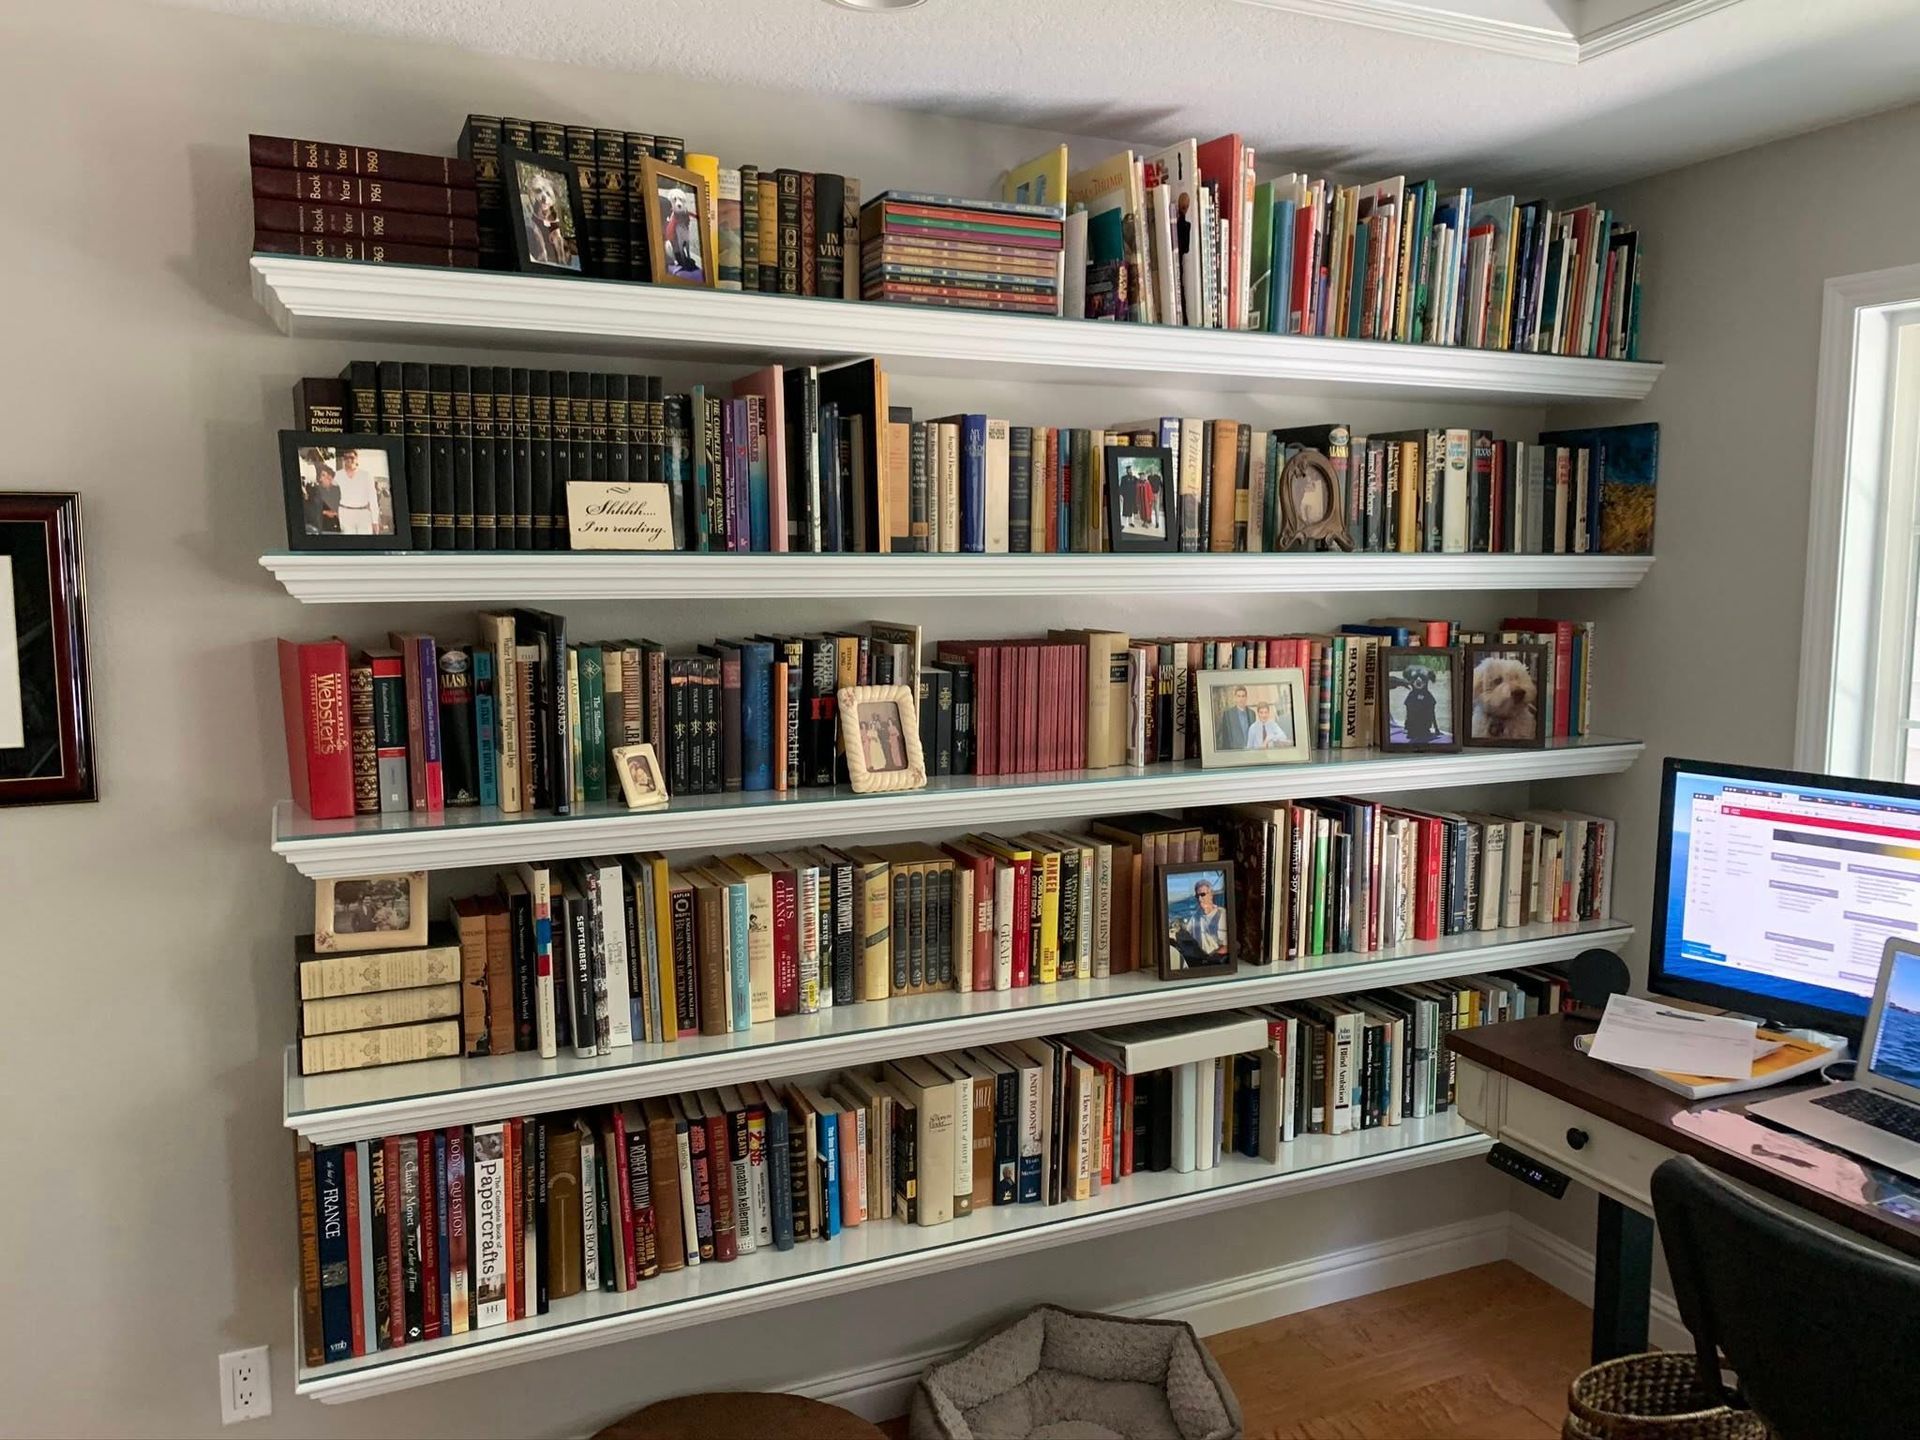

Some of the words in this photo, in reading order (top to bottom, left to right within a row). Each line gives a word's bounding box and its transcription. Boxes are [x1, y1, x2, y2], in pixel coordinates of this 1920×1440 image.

[368, 151, 378, 173] 1960
[310, 175, 321, 199] Book
[341, 180, 351, 201] Year
[371, 184, 382, 202] 1961
[313, 209, 324, 233] Book
[344, 213, 353, 234] Year
[373, 216, 384, 236] 1962
[315, 239, 324, 257] ook
[346, 243, 354, 260] ear
[820, 244, 843, 256] VIVO
[826, 233, 838, 244] IN
[373, 247, 384, 263] 963
[712, 399, 720, 415] THE
[749, 398, 758, 423] CLIVE
[713, 417, 721, 461] COMPLETE
[750, 425, 759, 462] CUSSLER
[1329, 446, 1349, 458] ALASKA
[1434, 434, 1446, 470] SPACE
[1475, 448, 1492, 457] TEXAS
[714, 463, 722, 486] BOOK
[716, 497, 724, 535] RUNNING
[613, 521, 667, 543] reading.
[556, 636, 564, 653] THE
[784, 643, 803, 655] STEPHEN
[1365, 643, 1377, 673] NAKED
[556, 655, 564, 671] ART
[789, 655, 799, 666] KING
[812, 652, 822, 687] KING
[820, 642, 834, 694] STEPHEN
[1348, 648, 1358, 687] BLACK
[442, 674, 468, 687] ALASKA
[557, 674, 564, 685] OF
[1364, 675, 1375, 700] CAME
[382, 683, 391, 713] Educational
[556, 686, 565, 715] SUSAN
[788, 701, 799, 719] The
[1176, 667, 1187, 735] NABOKOV
[318, 673, 337, 755] Webster's
[558, 715, 566, 736] RIOS
[383, 714, 391, 743] Leadership
[788, 720, 799, 741] Dark
[788, 742, 799, 766] Half
[1292, 827, 1300, 872] ULTIMATE
[1046, 857, 1058, 893] BANKER
[1468, 842, 1480, 898] Thousand
[802, 873, 817, 911] PATRICIA
[1064, 878, 1072, 916] WHITE
[1290, 875, 1300, 893] Spy
[734, 898, 743, 914] THE
[776, 880, 785, 927] CHANG
[786, 887, 795, 920] IRIS
[978, 902, 986, 932] TRIVIA
[1100, 888, 1109, 919] HOME
[1464, 902, 1477, 930] Days
[576, 915, 587, 971] SEPTEMBER
[675, 918, 685, 961] BUSINESS
[735, 915, 744, 945] SUGAR
[803, 911, 817, 954] CORNWELL
[1062, 917, 1071, 943] HOUSE
[1099, 920, 1109, 950] HINTS
[1000, 923, 1010, 965] GRAB
[580, 973, 587, 982] 11
[631, 959, 639, 992] DEVELOPMENT
[736, 946, 745, 988] SOLUTION
[677, 964, 687, 1019] DICTIONARY
[1339, 1047, 1349, 1067] Blind
[974, 1086, 991, 1110] JAZZ
[1029, 1072, 1038, 1097] ANDY
[1338, 1069, 1348, 1104] Ambition
[1082, 1095, 1091, 1111] How
[714, 1125, 723, 1139] THE
[736, 1122, 746, 1138] DR.
[1028, 1100, 1037, 1138] ROONEY
[1080, 1123, 1089, 1136] Say
[450, 1138, 461, 1168] BODY
[715, 1140, 724, 1149] DA
[737, 1140, 748, 1166] DEATH
[1081, 1138, 1089, 1146] It
[630, 1144, 647, 1176] ROBERT
[680, 1142, 689, 1170] Biology
[716, 1150, 725, 1171] VINCI
[1080, 1155, 1089, 1176] Work
[404, 1161, 415, 1193] Claude
[423, 1153, 432, 1200] RENAISSANCE
[717, 1172, 727, 1189] CODE
[734, 1162, 749, 1196] jonathan
[424, 1201, 432, 1209] IN
[494, 1190, 502, 1222] Complete
[632, 1177, 650, 1210] LUDLUM
[718, 1195, 727, 1209] DAN
[324, 1189, 341, 1239] FRANCE
[406, 1196, 416, 1227] Monet
[425, 1211, 433, 1230] ITALY
[451, 1181, 463, 1237] QUESTION
[478, 1163, 499, 1275] Papercrafts
[584, 1190, 595, 1231] TOASTS
[739, 1198, 751, 1237] kellerman
[407, 1234, 415, 1247] The
[585, 1233, 596, 1266] BOOK
[636, 1226, 646, 1266] PROTOCOL
[645, 1233, 656, 1260] SIGMA
[408, 1248, 416, 1268] Color
[426, 1248, 434, 1268] SPAIN
[376, 1256, 389, 1312] HINRICHS
[409, 1276, 418, 1293] Time
